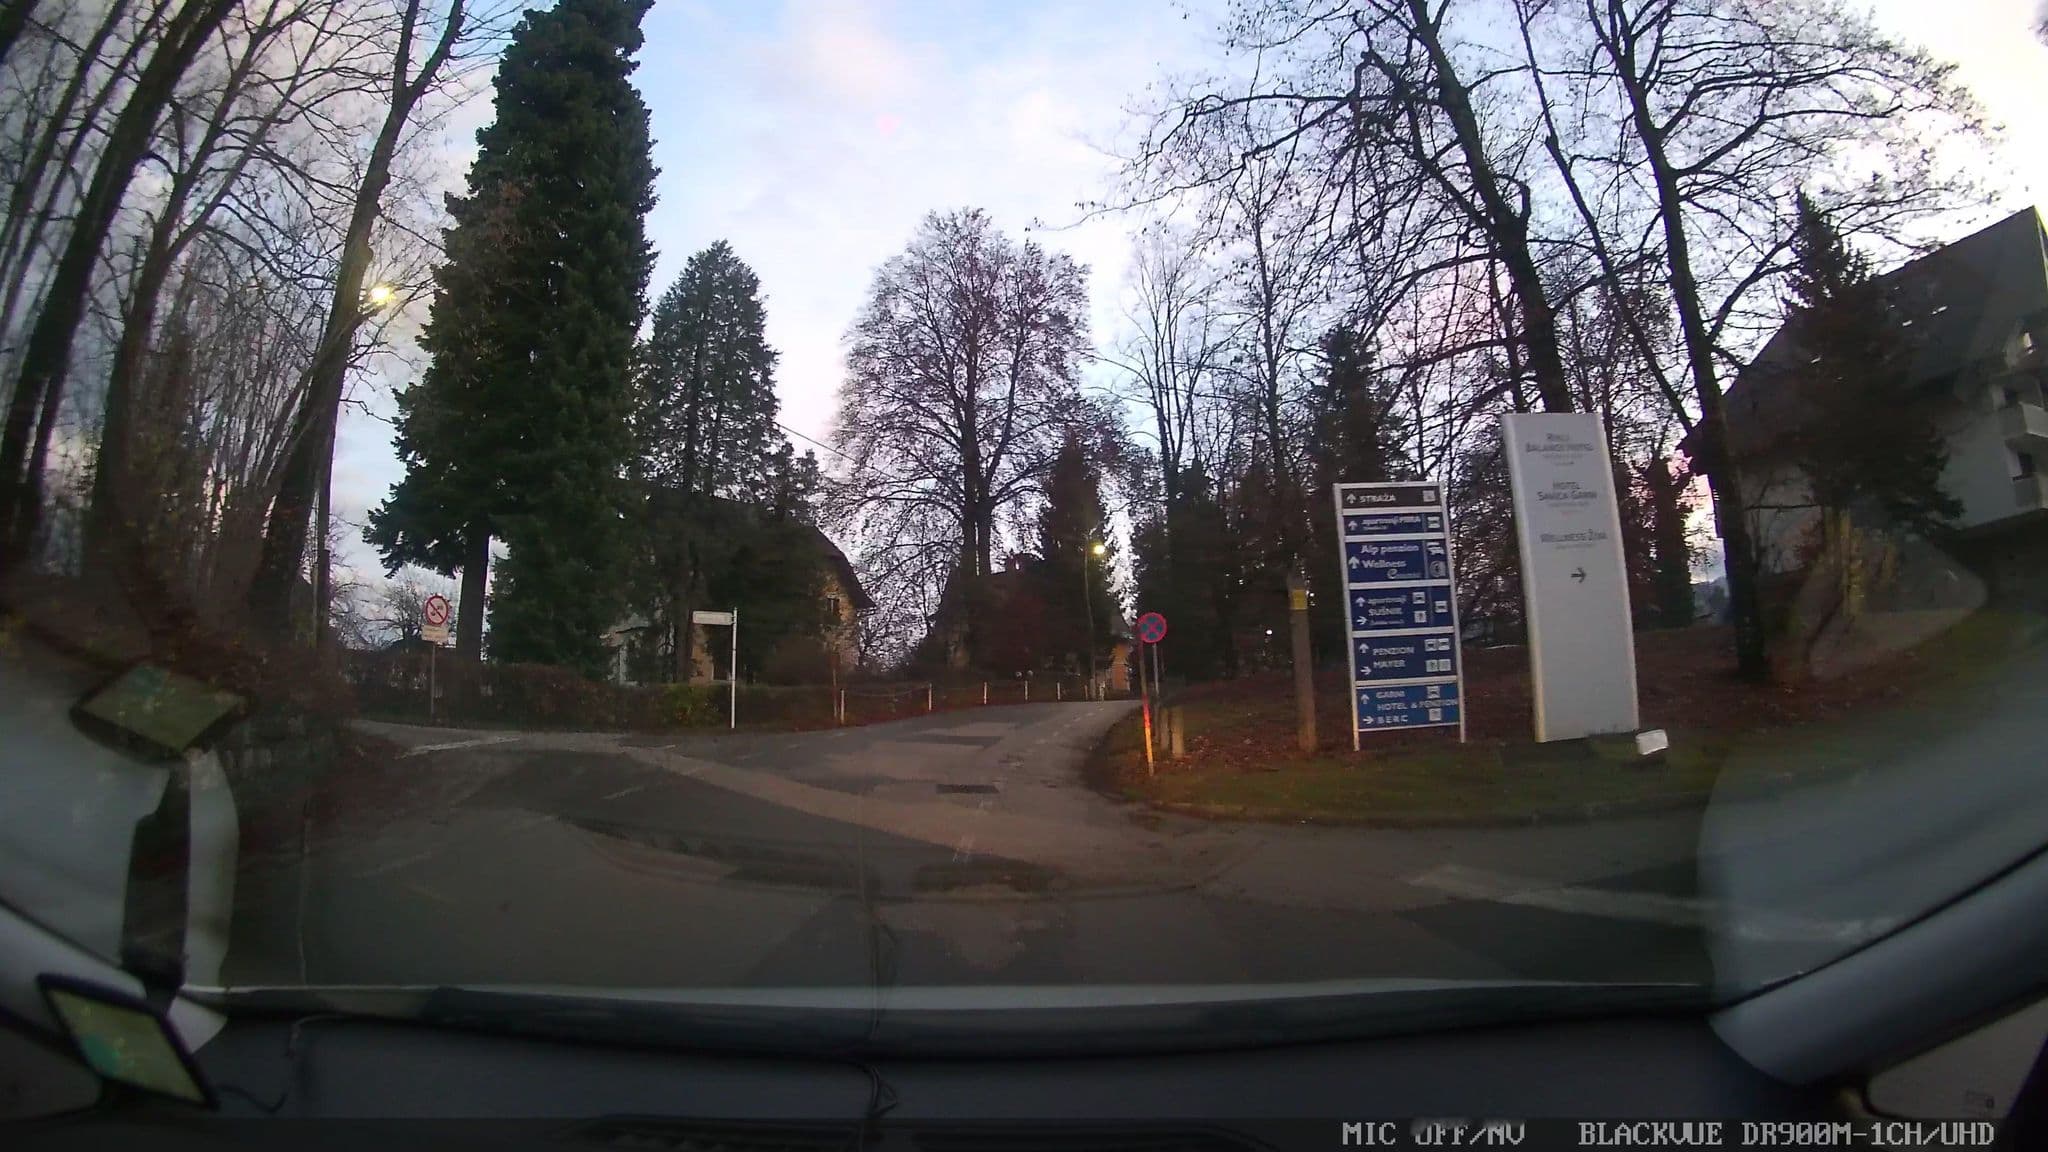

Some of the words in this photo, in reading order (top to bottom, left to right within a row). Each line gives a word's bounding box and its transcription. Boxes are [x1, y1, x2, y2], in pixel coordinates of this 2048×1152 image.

[1360, 545, 1379, 556] Alp
[1361, 560, 1406, 568] Wellness
[1373, 646, 1415, 656] PENZION
[1377, 702, 1408, 711] HOTEL
